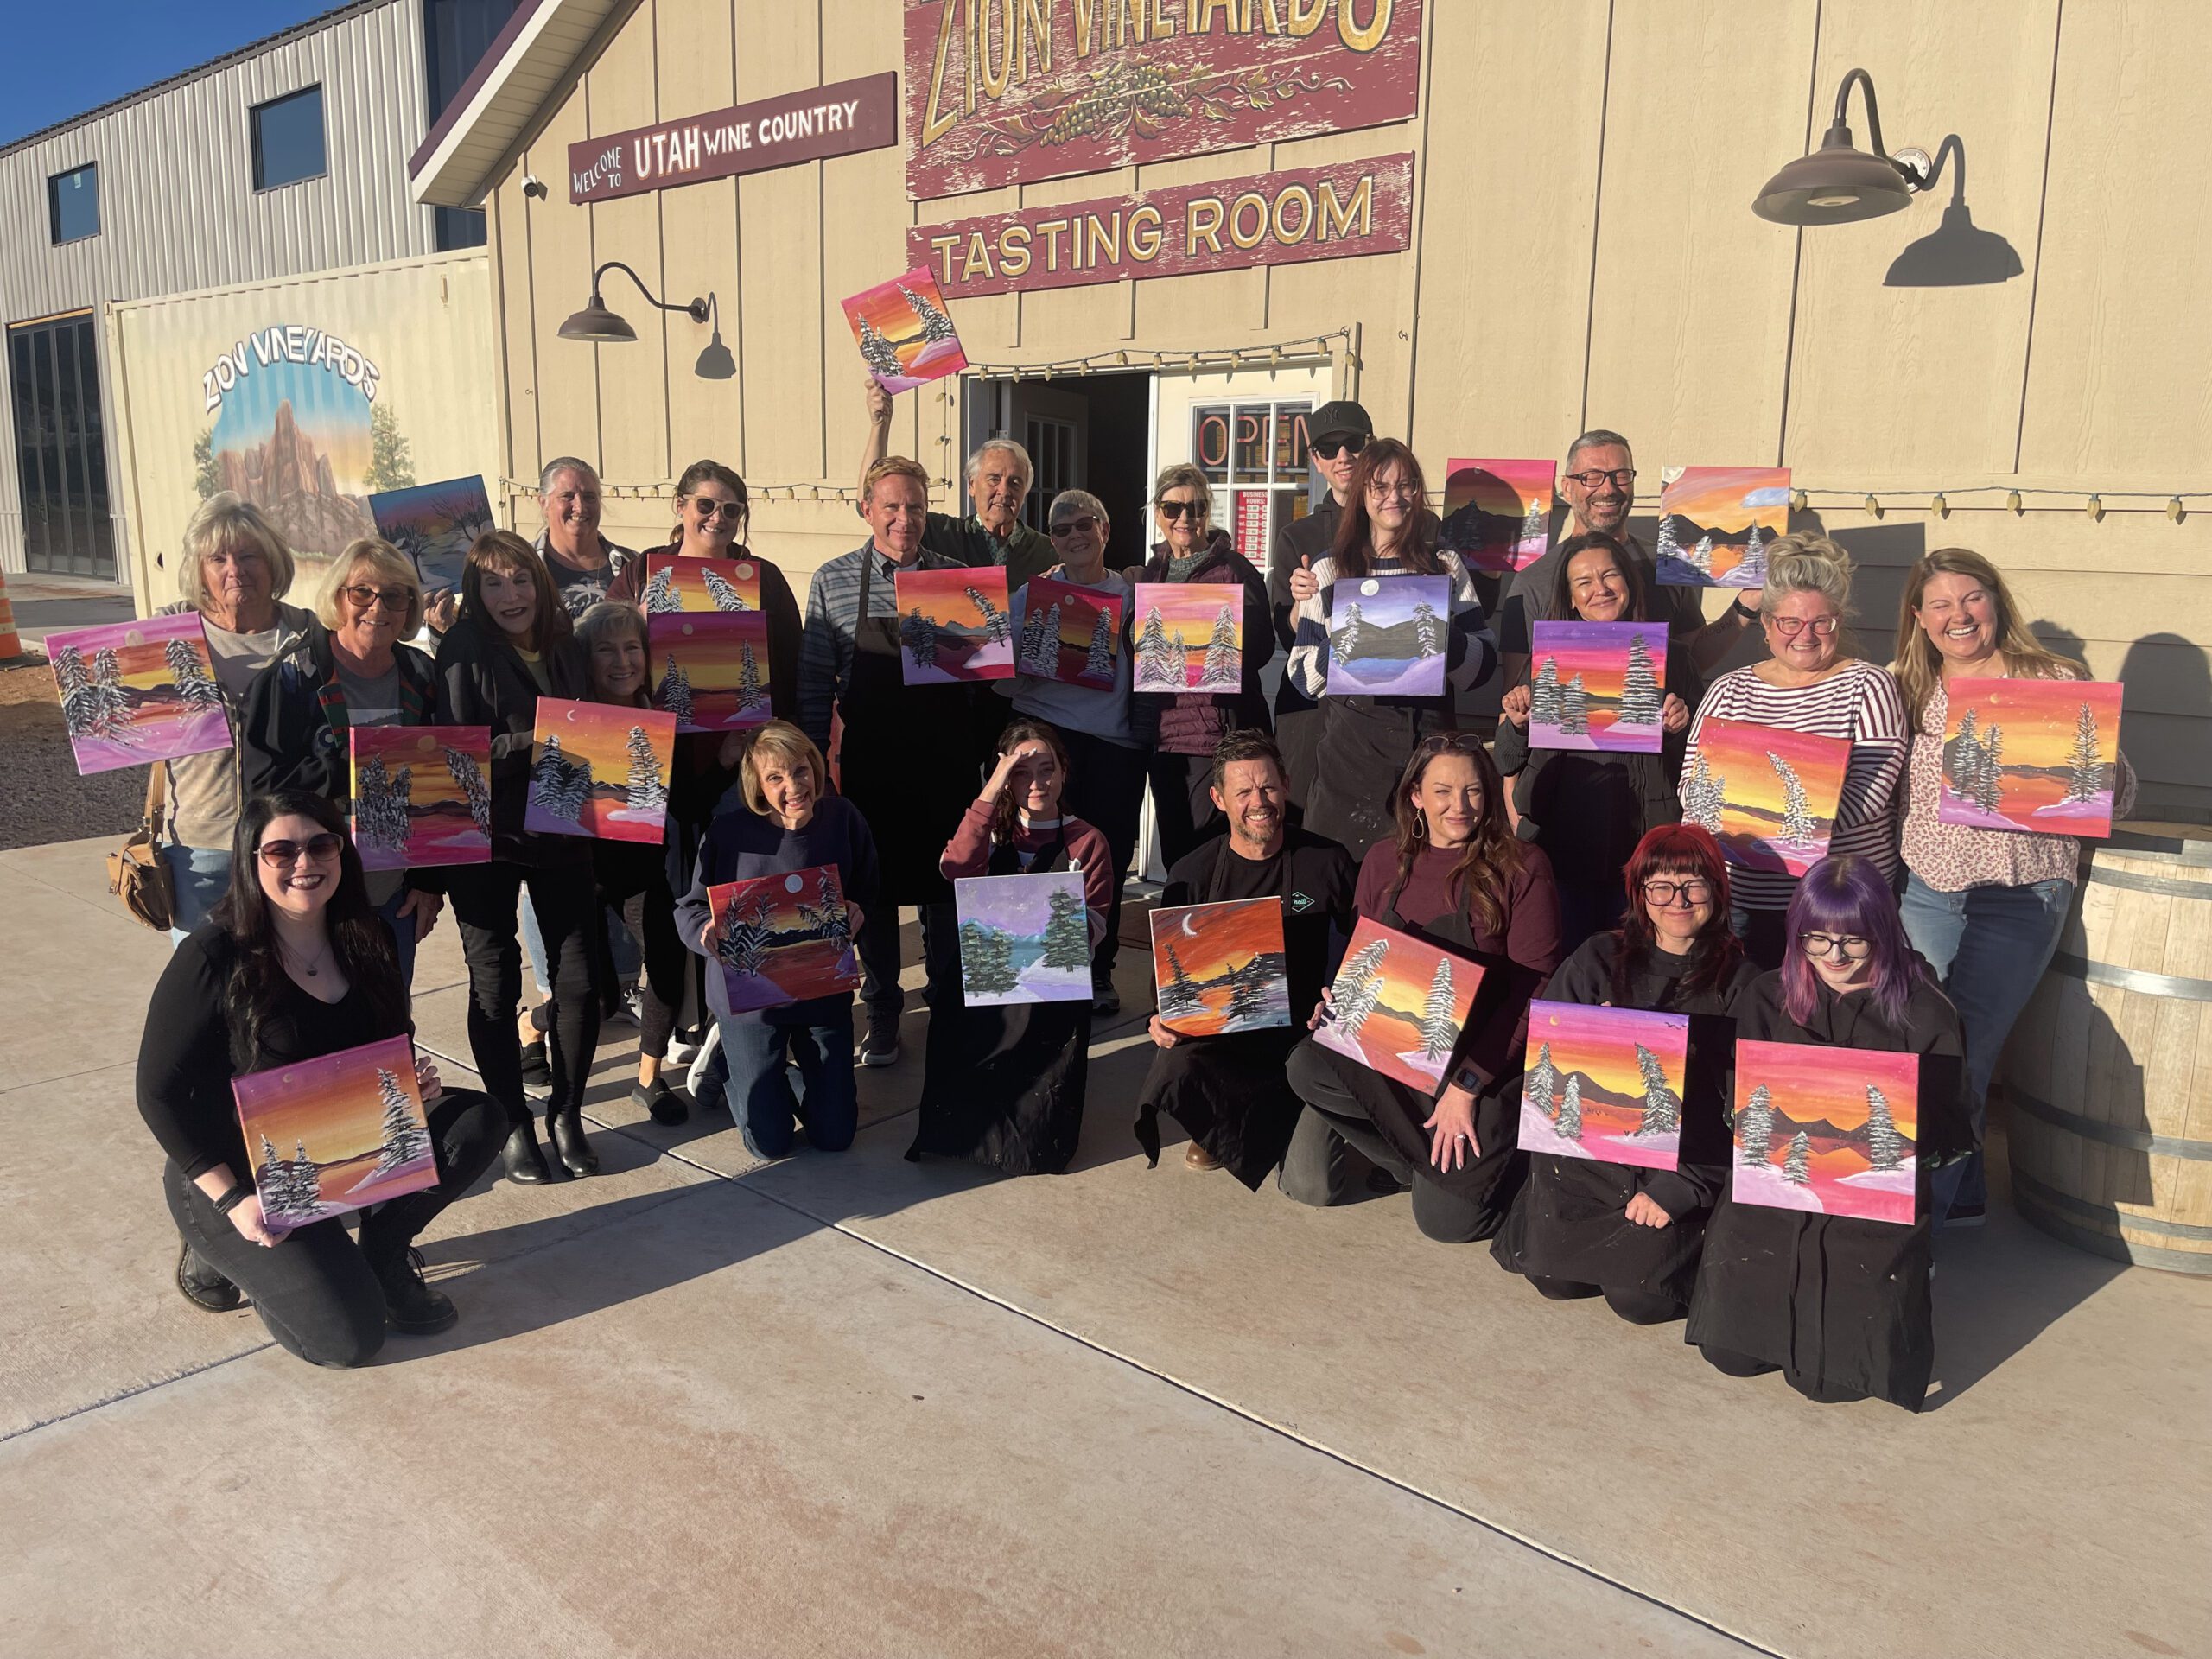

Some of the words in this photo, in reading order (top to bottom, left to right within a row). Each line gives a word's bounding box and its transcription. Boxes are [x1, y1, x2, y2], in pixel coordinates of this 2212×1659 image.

[922, 0, 1053, 150] ZION
[573, 146, 622, 194] WELCOME
[607, 173, 622, 188] TO
[634, 124, 701, 181] UTAH
[703, 122, 753, 156] WINE
[758, 99, 861, 146] COUNTRY
[931, 203, 1165, 286] TASTING
[1185, 175, 1376, 259] ROOM
[203, 341, 250, 416] ZION
[250, 325, 381, 403] VINEYARDS
[1198, 416, 1311, 467] OPEN
